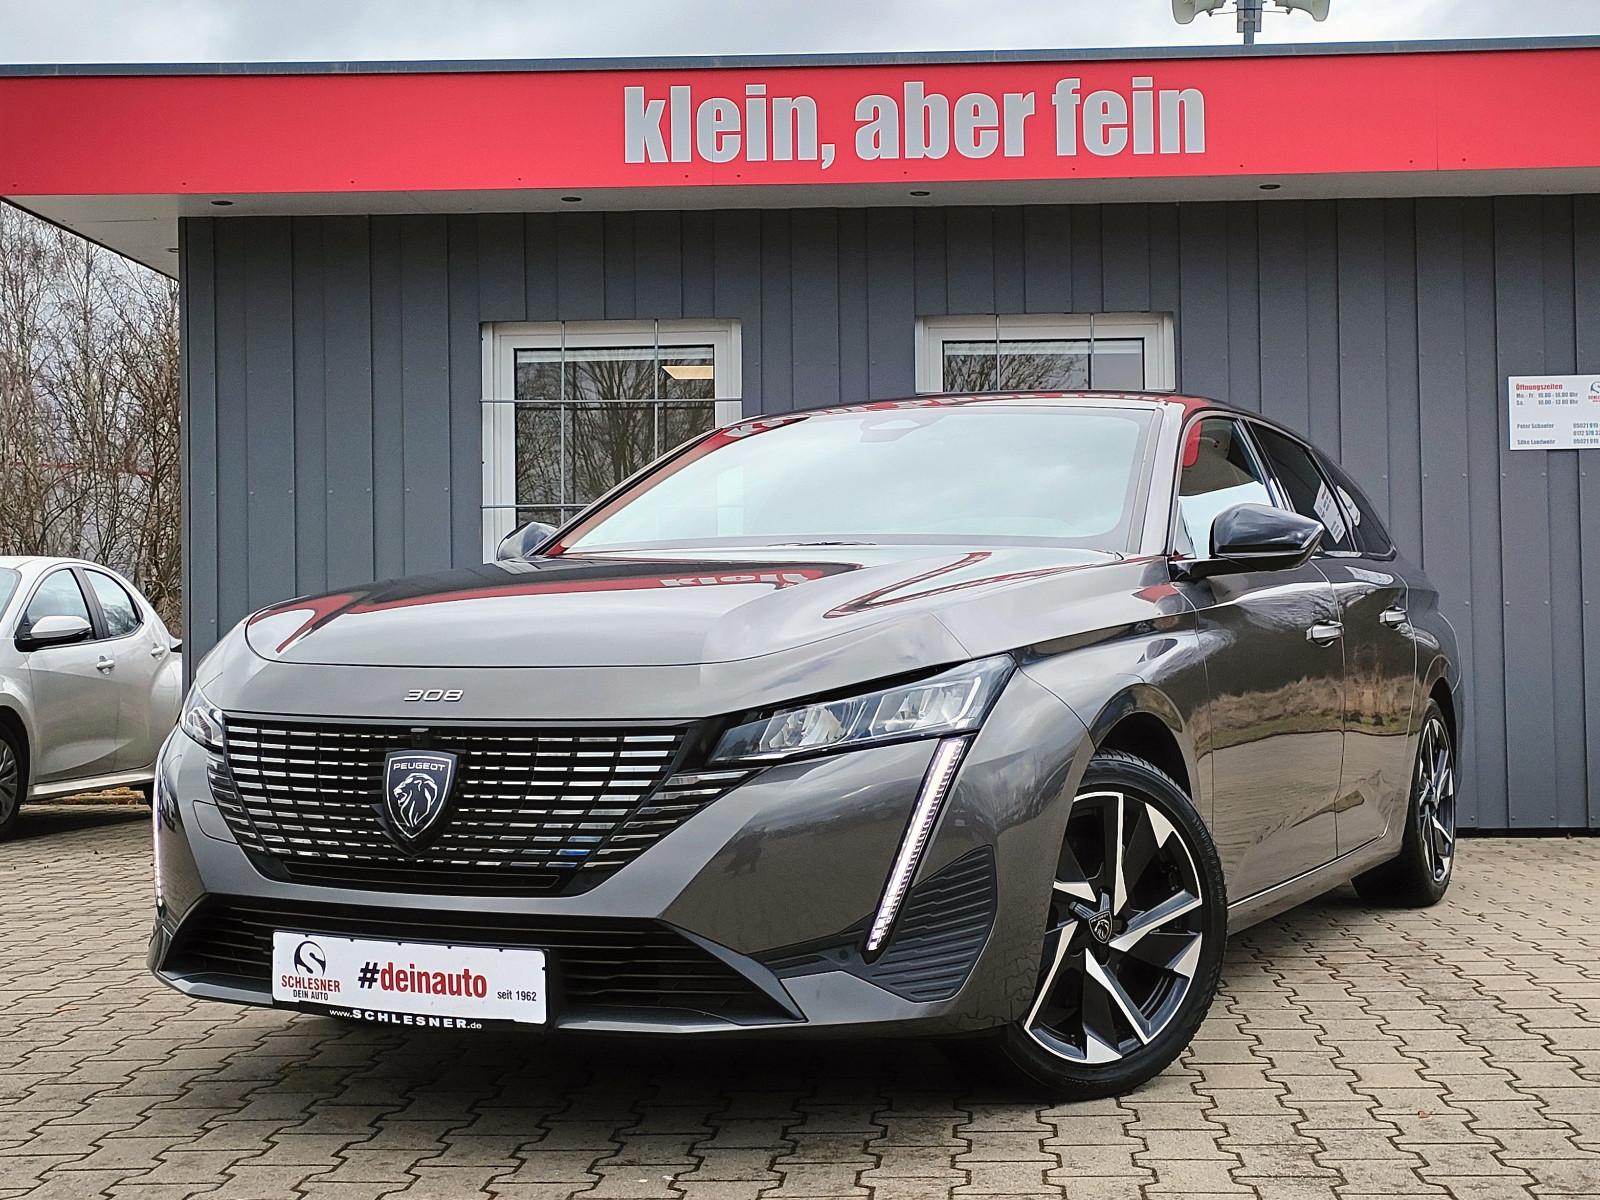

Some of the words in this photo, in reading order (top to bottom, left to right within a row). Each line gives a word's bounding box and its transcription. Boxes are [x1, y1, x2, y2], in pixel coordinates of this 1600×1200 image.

[623, 83, 836, 170] klein,
[854, 80, 1036, 161] aber
[1051, 75, 1206, 157] fein
[404, 689, 464, 702] 308
[393, 762, 446, 772] PEUGEOT
[281, 975, 341, 993] SCHLESNER
[358, 961, 487, 998] #deinauto
[497, 990, 512, 1000] seit
[515, 990, 537, 1002] 1962
[293, 990, 309, 999] DEIN
[310, 992, 328, 1001] AUTO
